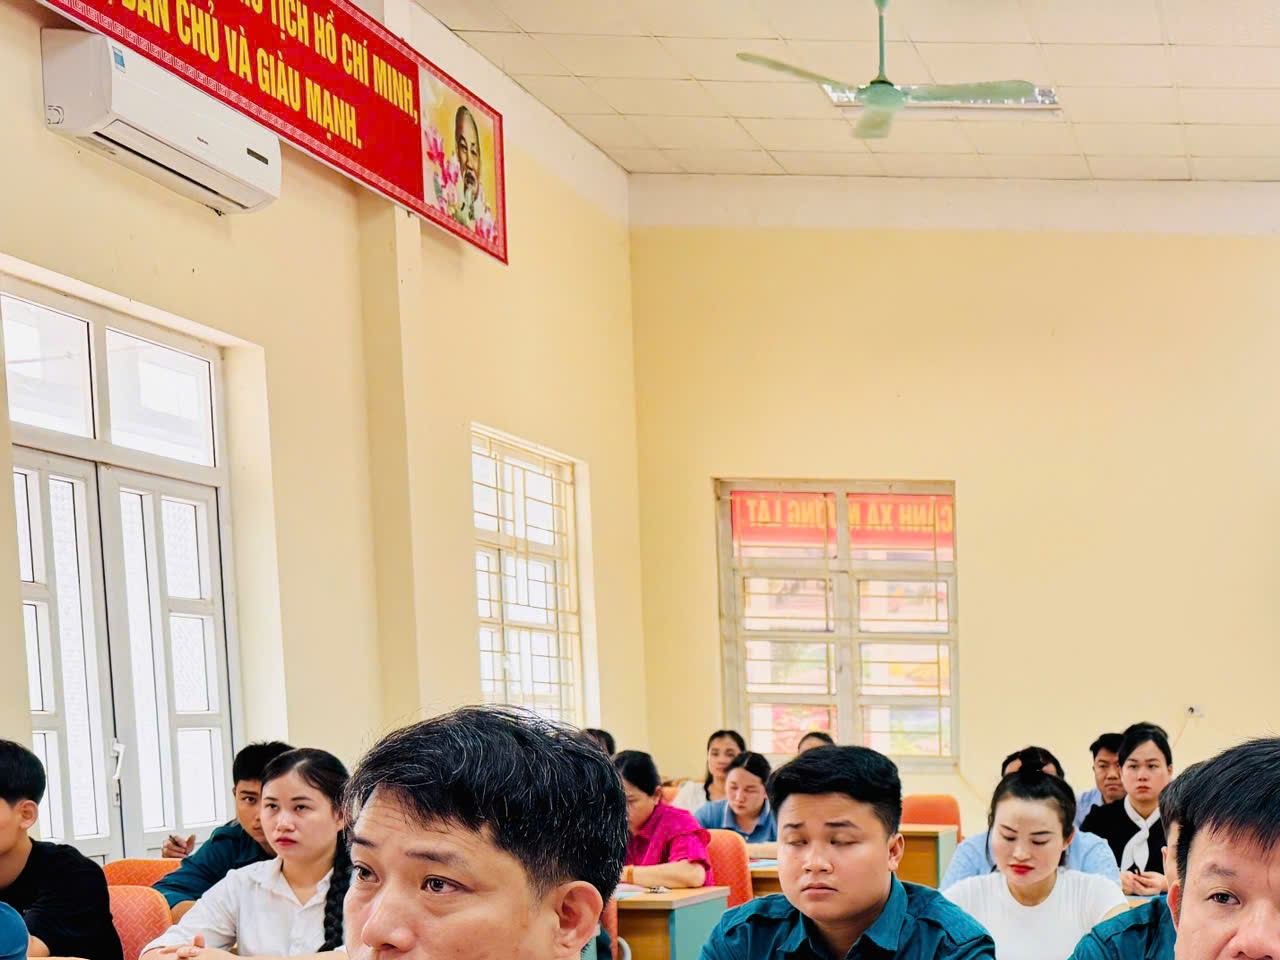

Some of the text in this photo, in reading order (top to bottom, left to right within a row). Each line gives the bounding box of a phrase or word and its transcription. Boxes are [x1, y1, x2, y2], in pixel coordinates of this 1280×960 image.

[175, 0, 220, 63] CHỦ
[223, 24, 254, 85] VÀ
[256, 47, 301, 112] GIÀU
[304, 76, 363, 150] MẠNH.
[313, 9, 338, 65] HỒ
[341, 32, 370, 87] CHÍ
[372, 53, 419, 125] MINH,
